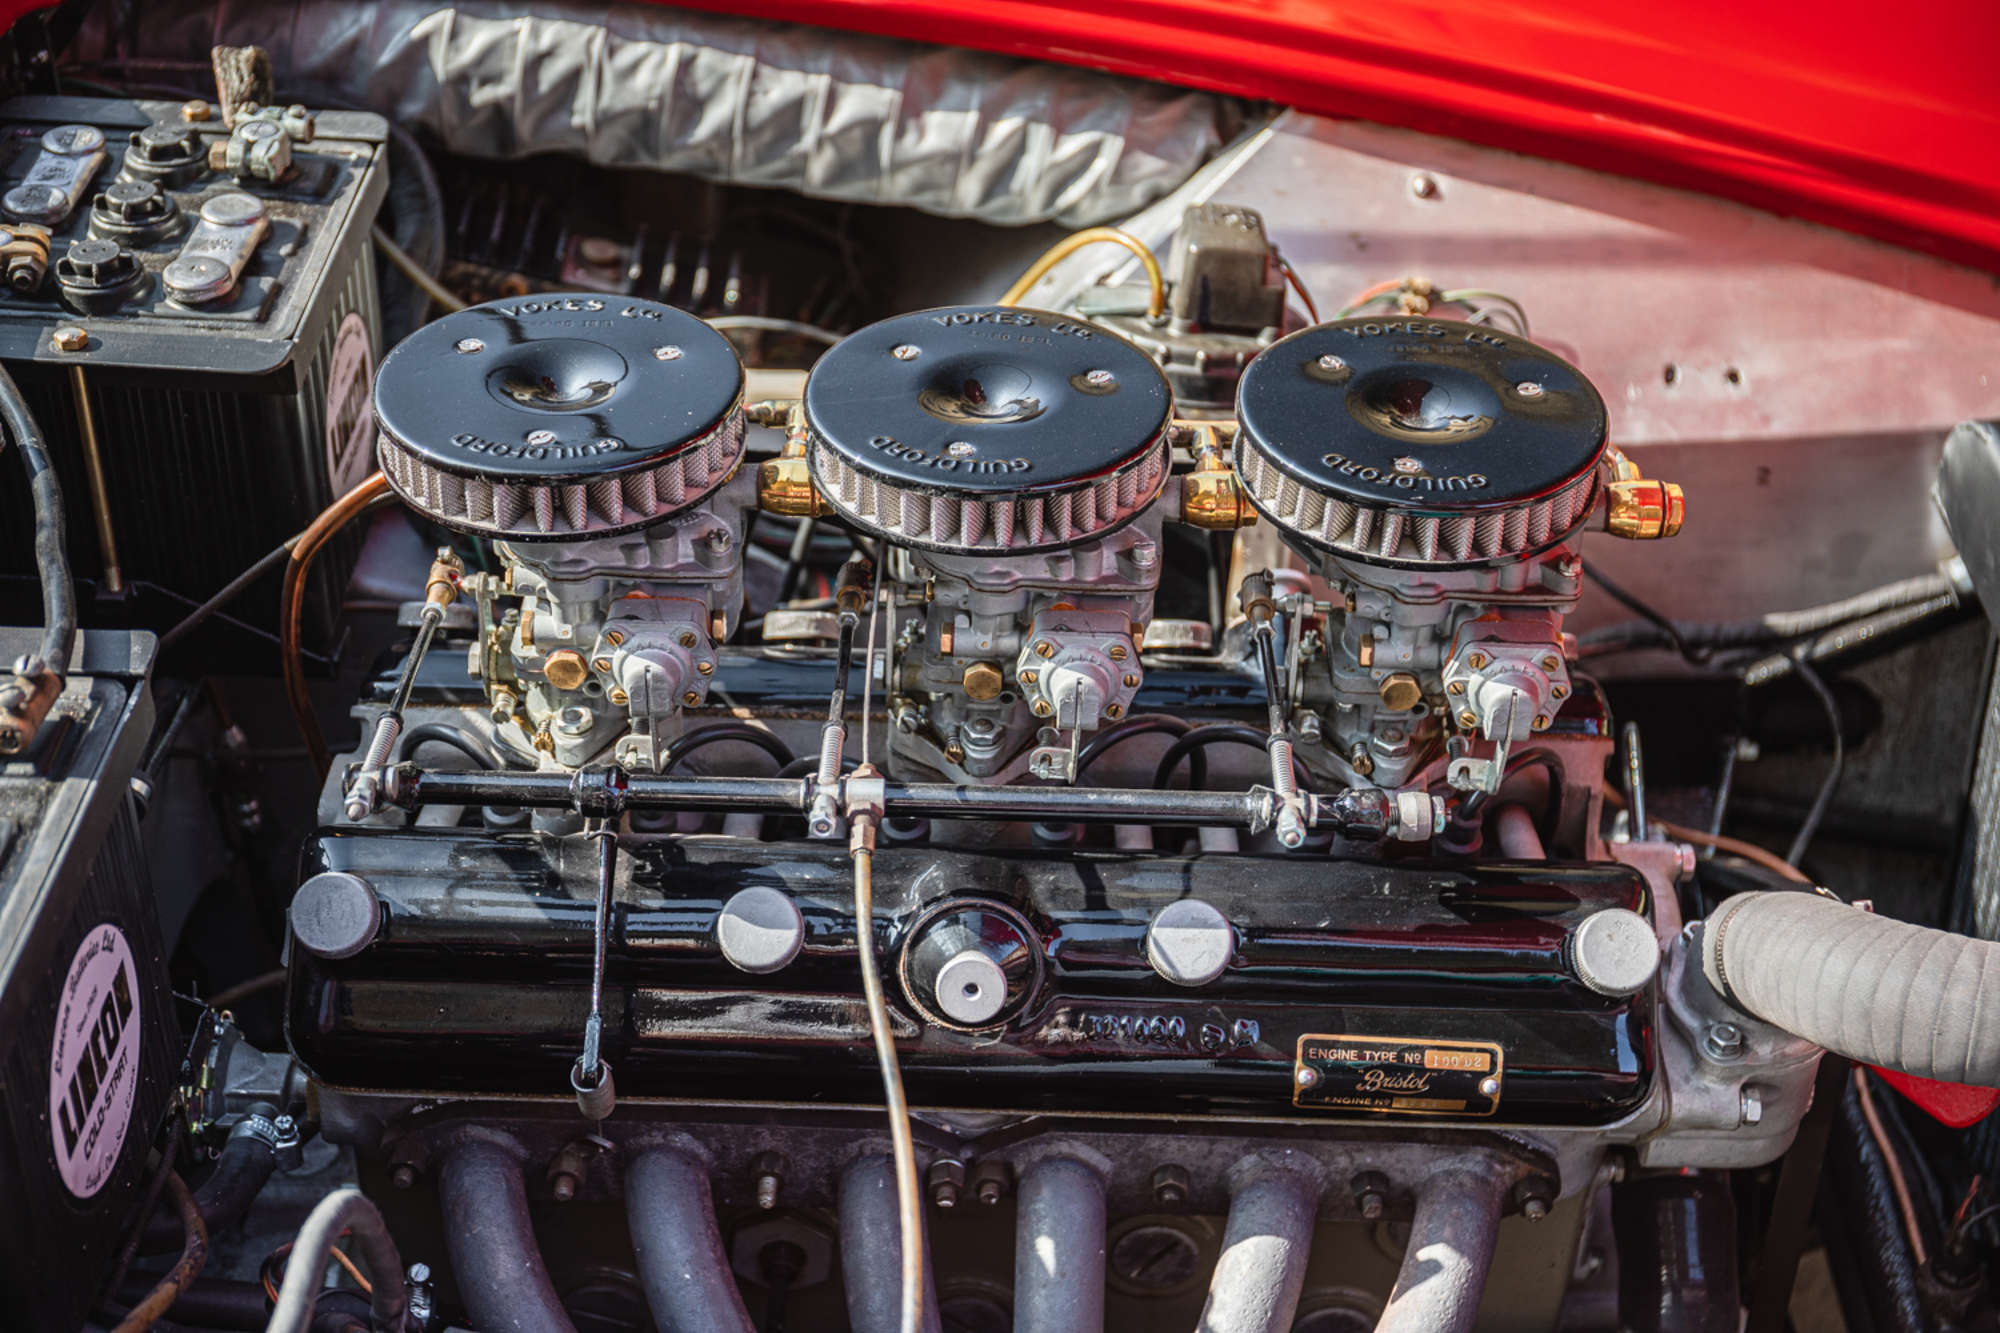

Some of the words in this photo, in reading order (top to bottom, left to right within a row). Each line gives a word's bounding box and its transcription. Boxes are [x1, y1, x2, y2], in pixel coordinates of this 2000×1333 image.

[500, 299, 605, 317] VOKES
[932, 312, 1036, 327] VOKES
[1343, 322, 1446, 338] VOKES
[451, 432, 620, 460] GUILDFORD
[869, 435, 1032, 473] GUILDFORD
[1321, 453, 1489, 491] GUILDFORD
[58, 957, 133, 1162] LINCON
[1308, 1048, 1358, 1061] ENGINE
[1364, 1050, 1398, 1063] TYPE
[84, 1047, 128, 1161] COLD-START
[1324, 1096, 1371, 1105] ENGINE
